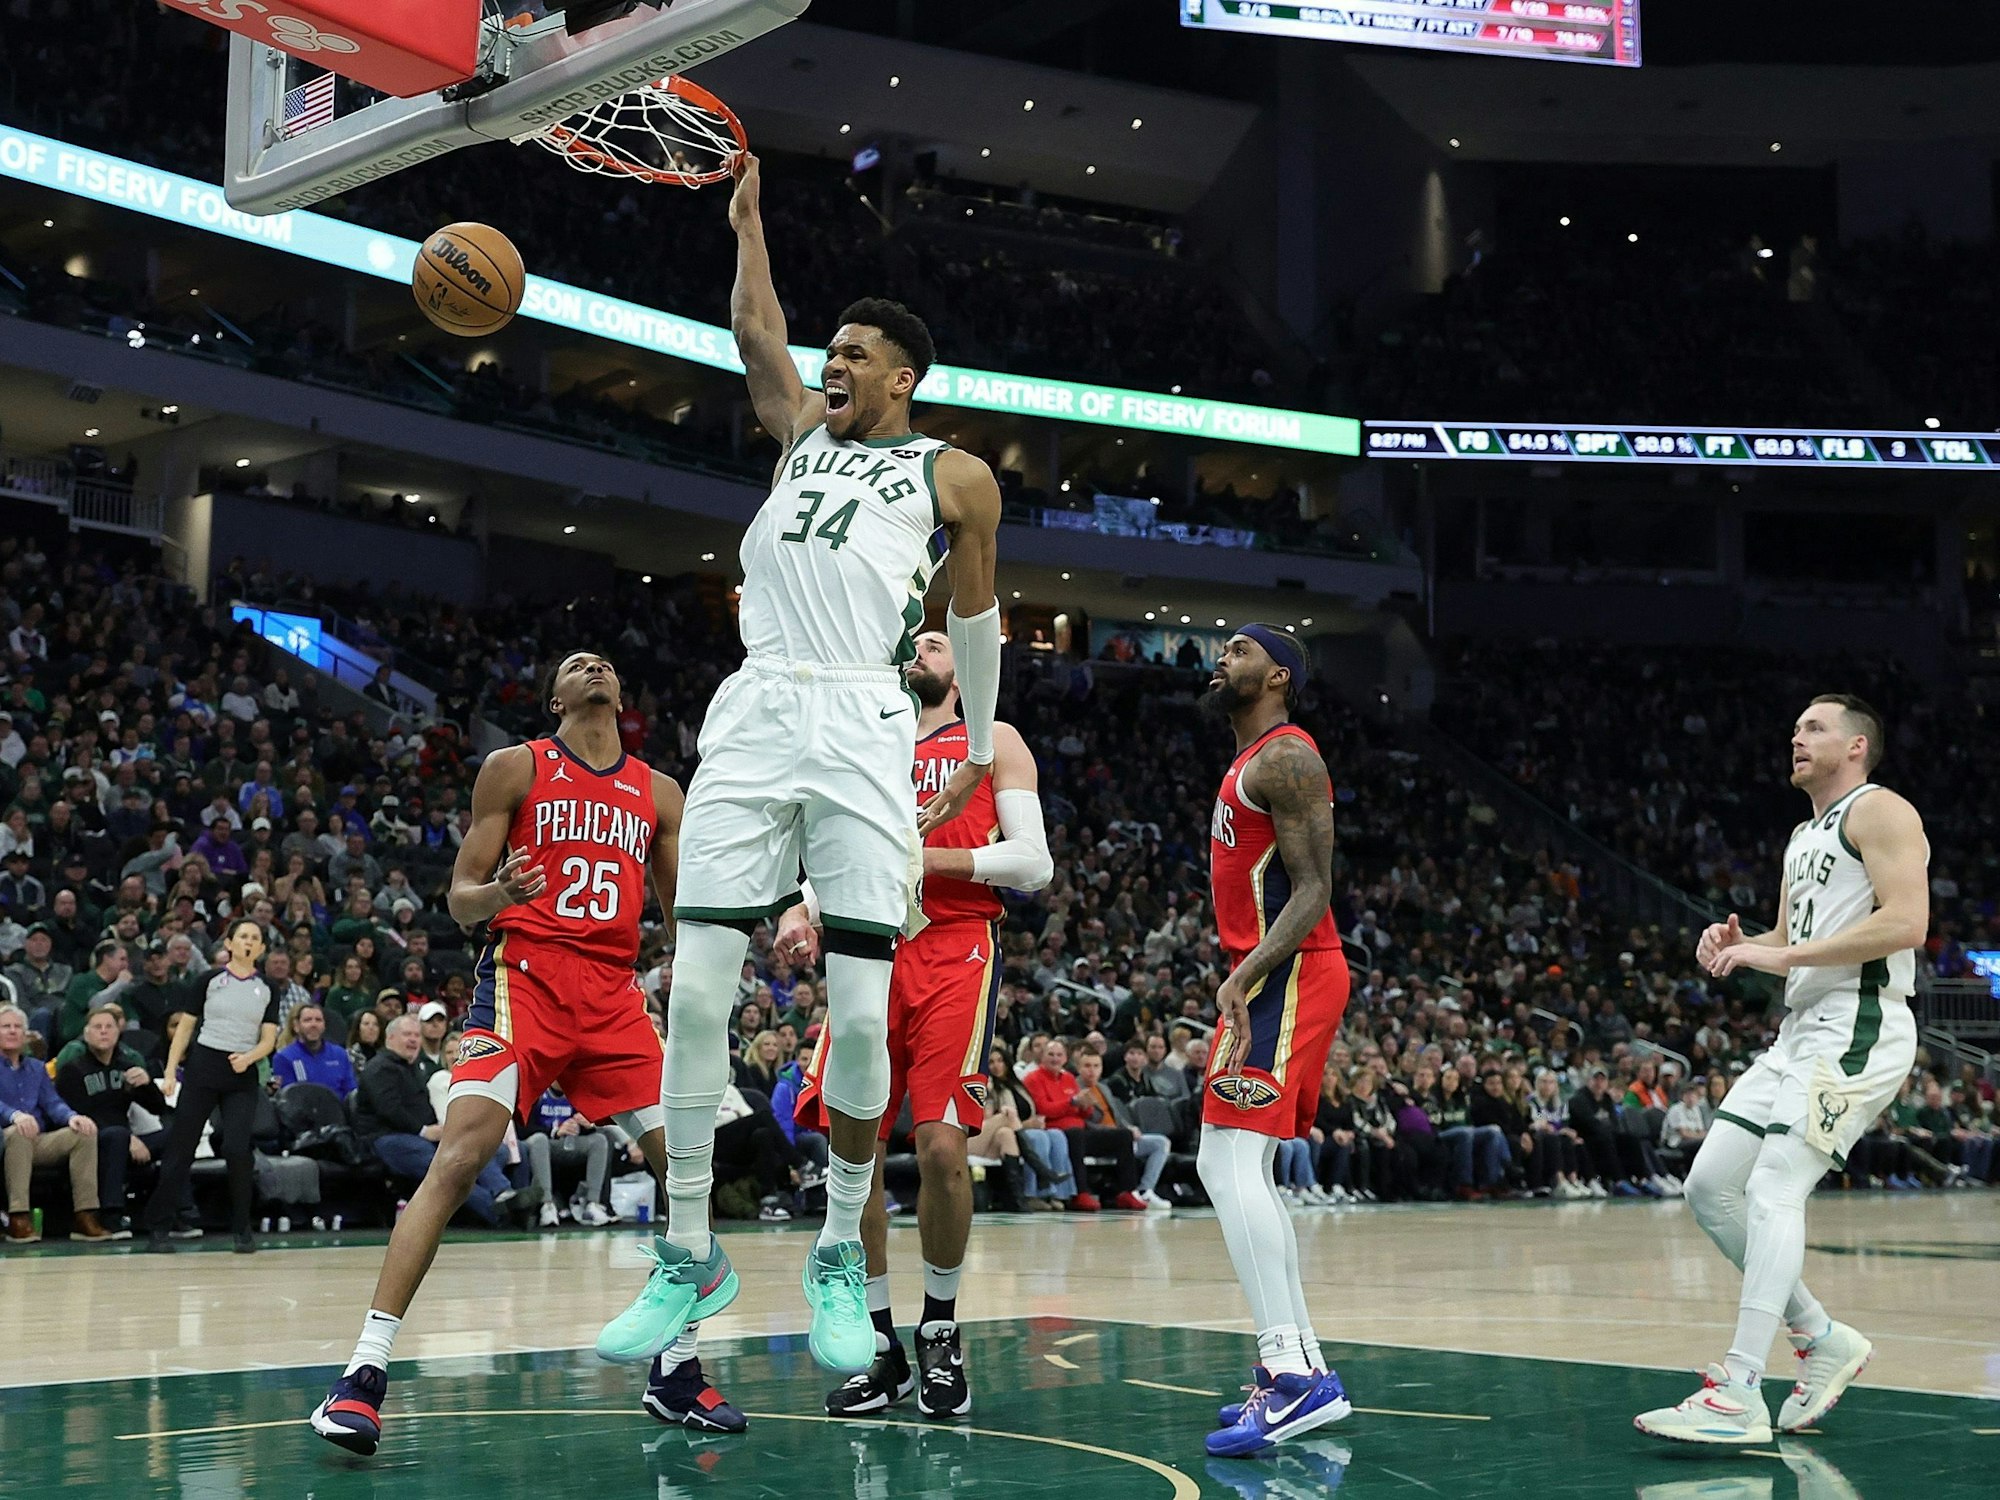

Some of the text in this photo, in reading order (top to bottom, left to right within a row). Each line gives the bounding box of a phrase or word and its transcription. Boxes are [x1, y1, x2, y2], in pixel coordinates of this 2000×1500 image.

[519, 30, 743, 124] SHOP.BUCKS.COM
[0, 136, 47, 174] OF
[57, 152, 170, 208] FISERV
[274, 139, 455, 210] SHOP.BUCKS.COM
[432, 237, 492, 296] Wilson
[588, 300, 722, 360] CONTROLS.
[957, 374, 1073, 413] PARTNER
[1080, 391, 1115, 417] OF
[1121, 396, 1206, 429] FISERV
[1213, 408, 1299, 441] FORUM
[1402, 433, 1427, 448] PM
[1458, 431, 1489, 450] FG
[1575, 433, 1620, 453] 3PT
[1705, 436, 1736, 456] FT
[1822, 438, 1865, 458] FLS
[1930, 440, 1977, 461] TOL
[790, 451, 917, 505] BUCKS
[781, 490, 860, 551] 34
[914, 758, 964, 792] CAN
[535, 799, 651, 865] PELICANS
[556, 856, 620, 921] 25
